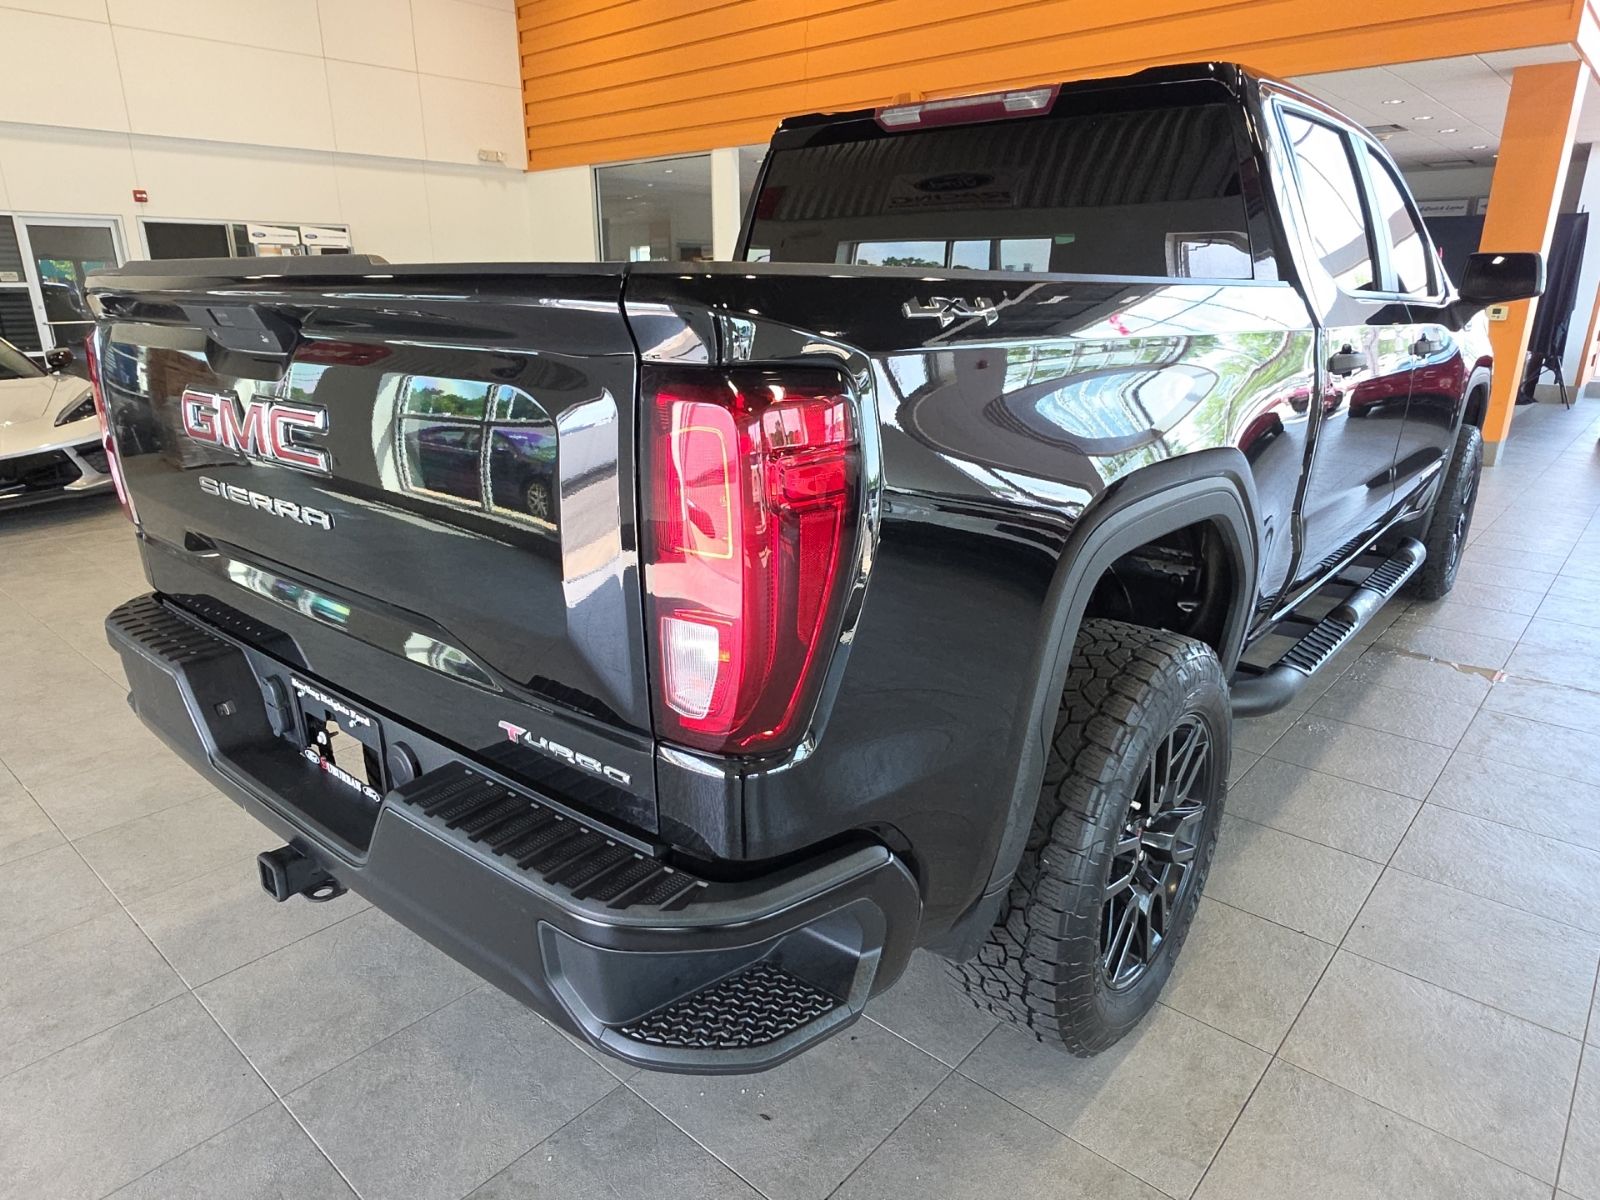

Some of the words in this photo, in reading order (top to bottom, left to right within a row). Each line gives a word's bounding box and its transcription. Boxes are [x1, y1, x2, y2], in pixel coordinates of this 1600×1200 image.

[182, 387, 333, 477] GMC
[198, 475, 336, 531] SIERRA
[498, 719, 632, 786] TURBO
